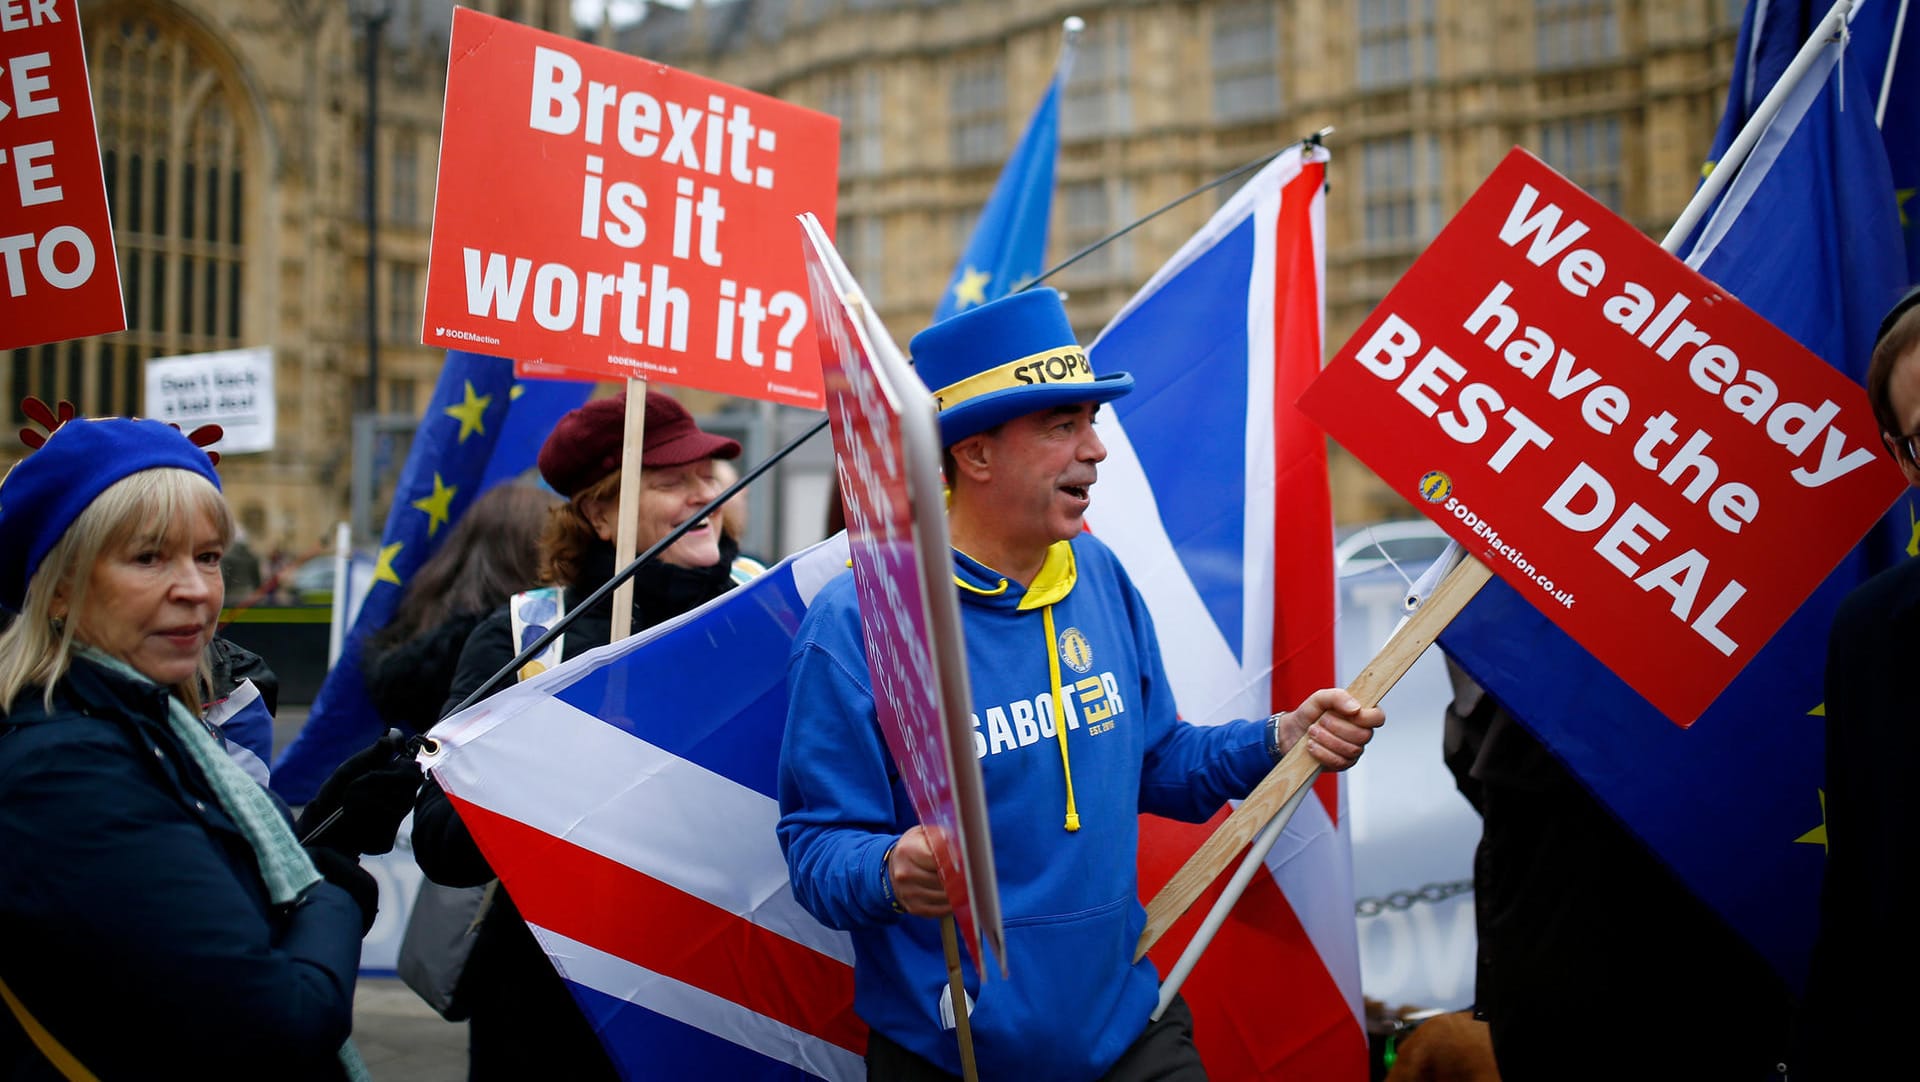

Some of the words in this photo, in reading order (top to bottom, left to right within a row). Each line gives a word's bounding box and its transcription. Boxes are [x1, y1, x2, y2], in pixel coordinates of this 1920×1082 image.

[530, 46, 776, 190] Brexit:
[581, 154, 648, 248] is
[673, 176, 726, 267] it
[446, 328, 500, 345] SODEMaction
[464, 247, 690, 353] worth
[716, 279, 809, 373] it?
[1014, 354, 1077, 385] STOP
[1499, 184, 1605, 297] We
[1603, 282, 1876, 488] already
[1463, 281, 1630, 434] have
[1634, 411, 1760, 533] the
[1355, 313, 1553, 473] BEST
[1542, 462, 1747, 657] DEAL
[1445, 498, 1576, 609] SODEMaction.co.uk
